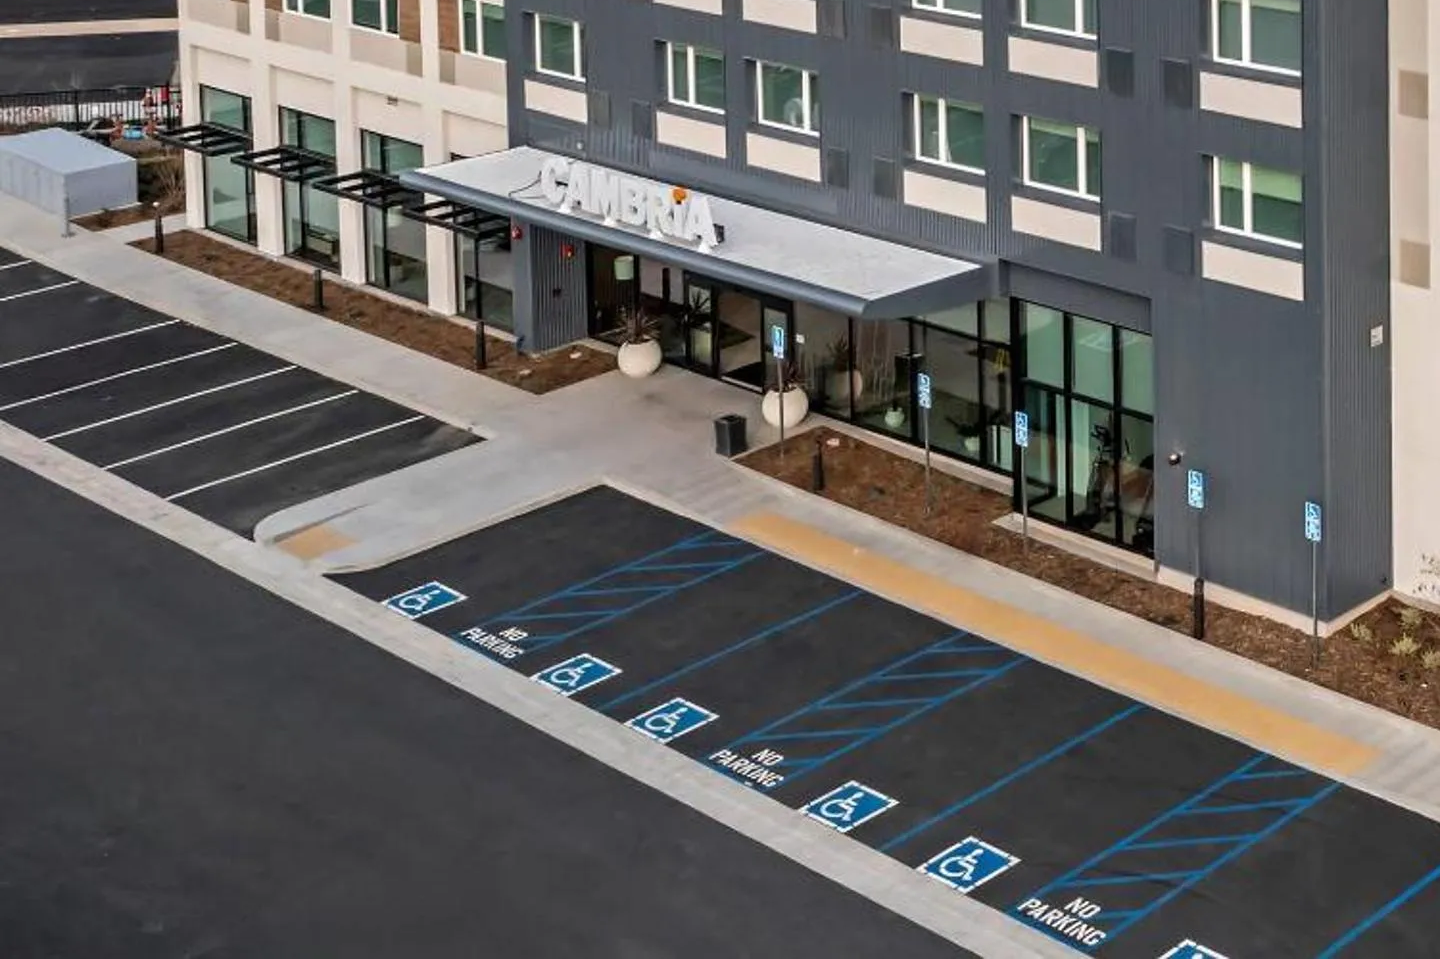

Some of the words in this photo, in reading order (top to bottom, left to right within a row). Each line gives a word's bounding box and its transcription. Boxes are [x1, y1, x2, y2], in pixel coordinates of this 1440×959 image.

[499, 626, 528, 641] NO
[708, 749, 784, 787] PARKING
[751, 748, 784, 766] NO
[1063, 897, 1101, 919] NO
[1017, 898, 1106, 945] PARKING
